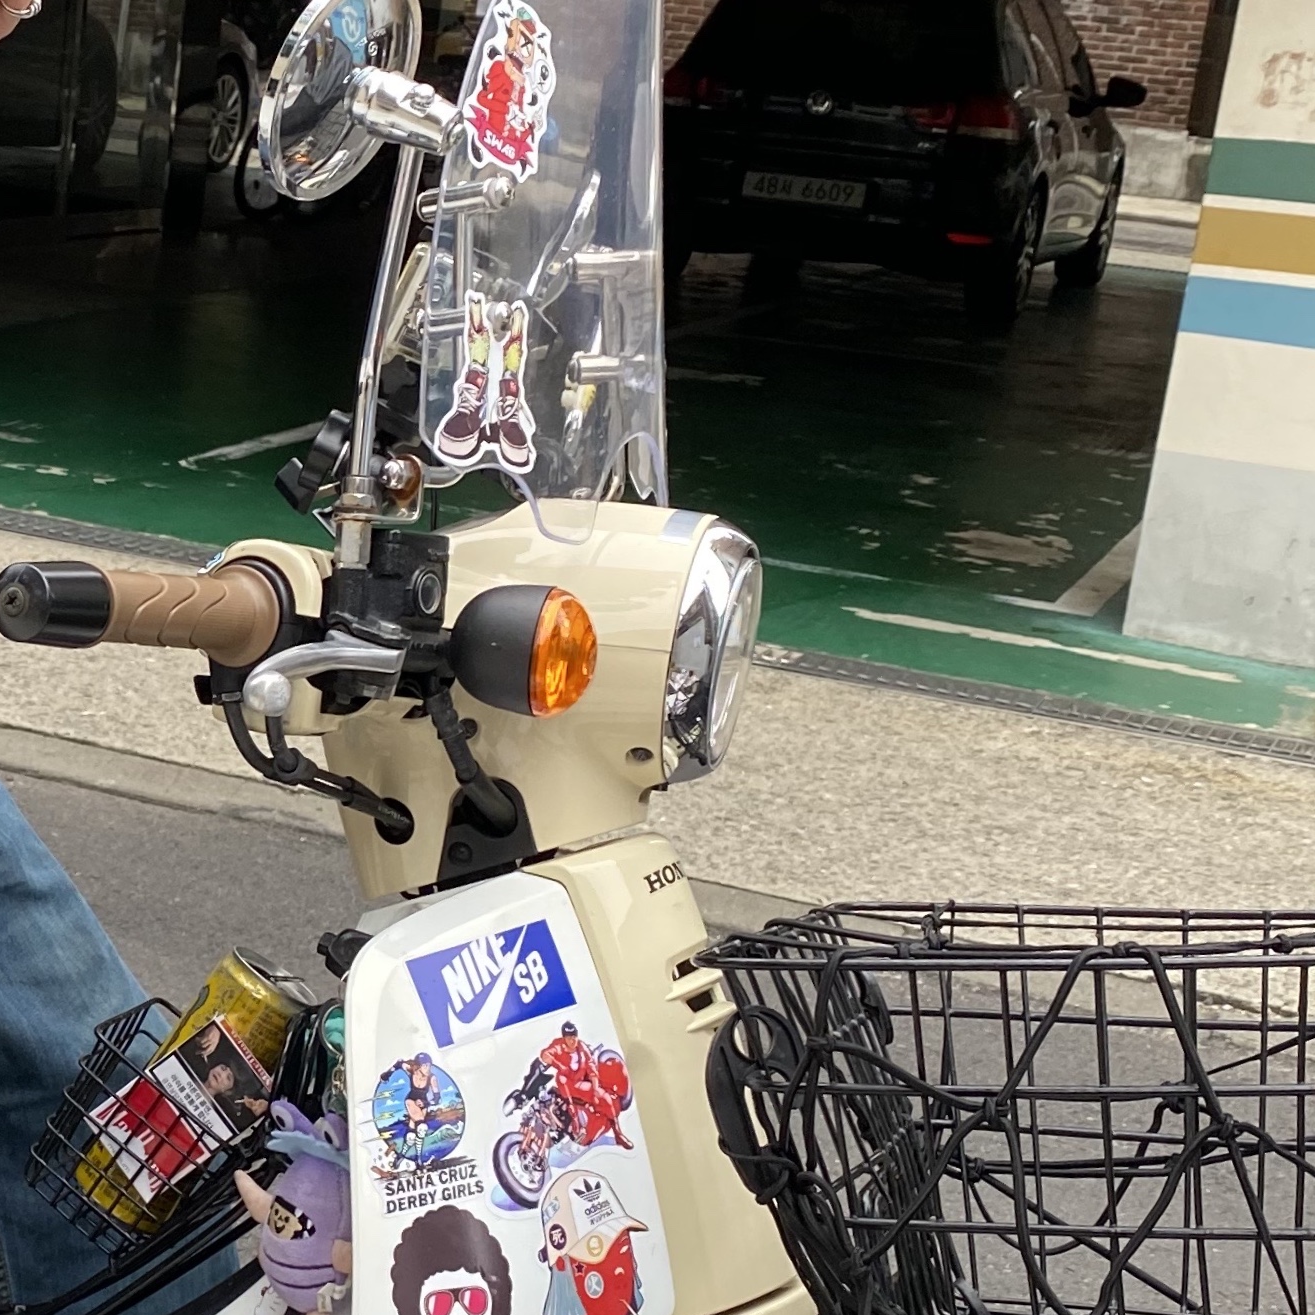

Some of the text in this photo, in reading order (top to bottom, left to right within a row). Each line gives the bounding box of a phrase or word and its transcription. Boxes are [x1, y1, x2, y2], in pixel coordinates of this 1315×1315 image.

[484, 129, 516, 160] SWAG
[801, 180, 856, 203] 6609
[441, 933, 549, 1014] NIKE SB
[385, 1164, 478, 1197] SANTA CRUZ
[386, 1180, 484, 1214] DERBY GIRLS
